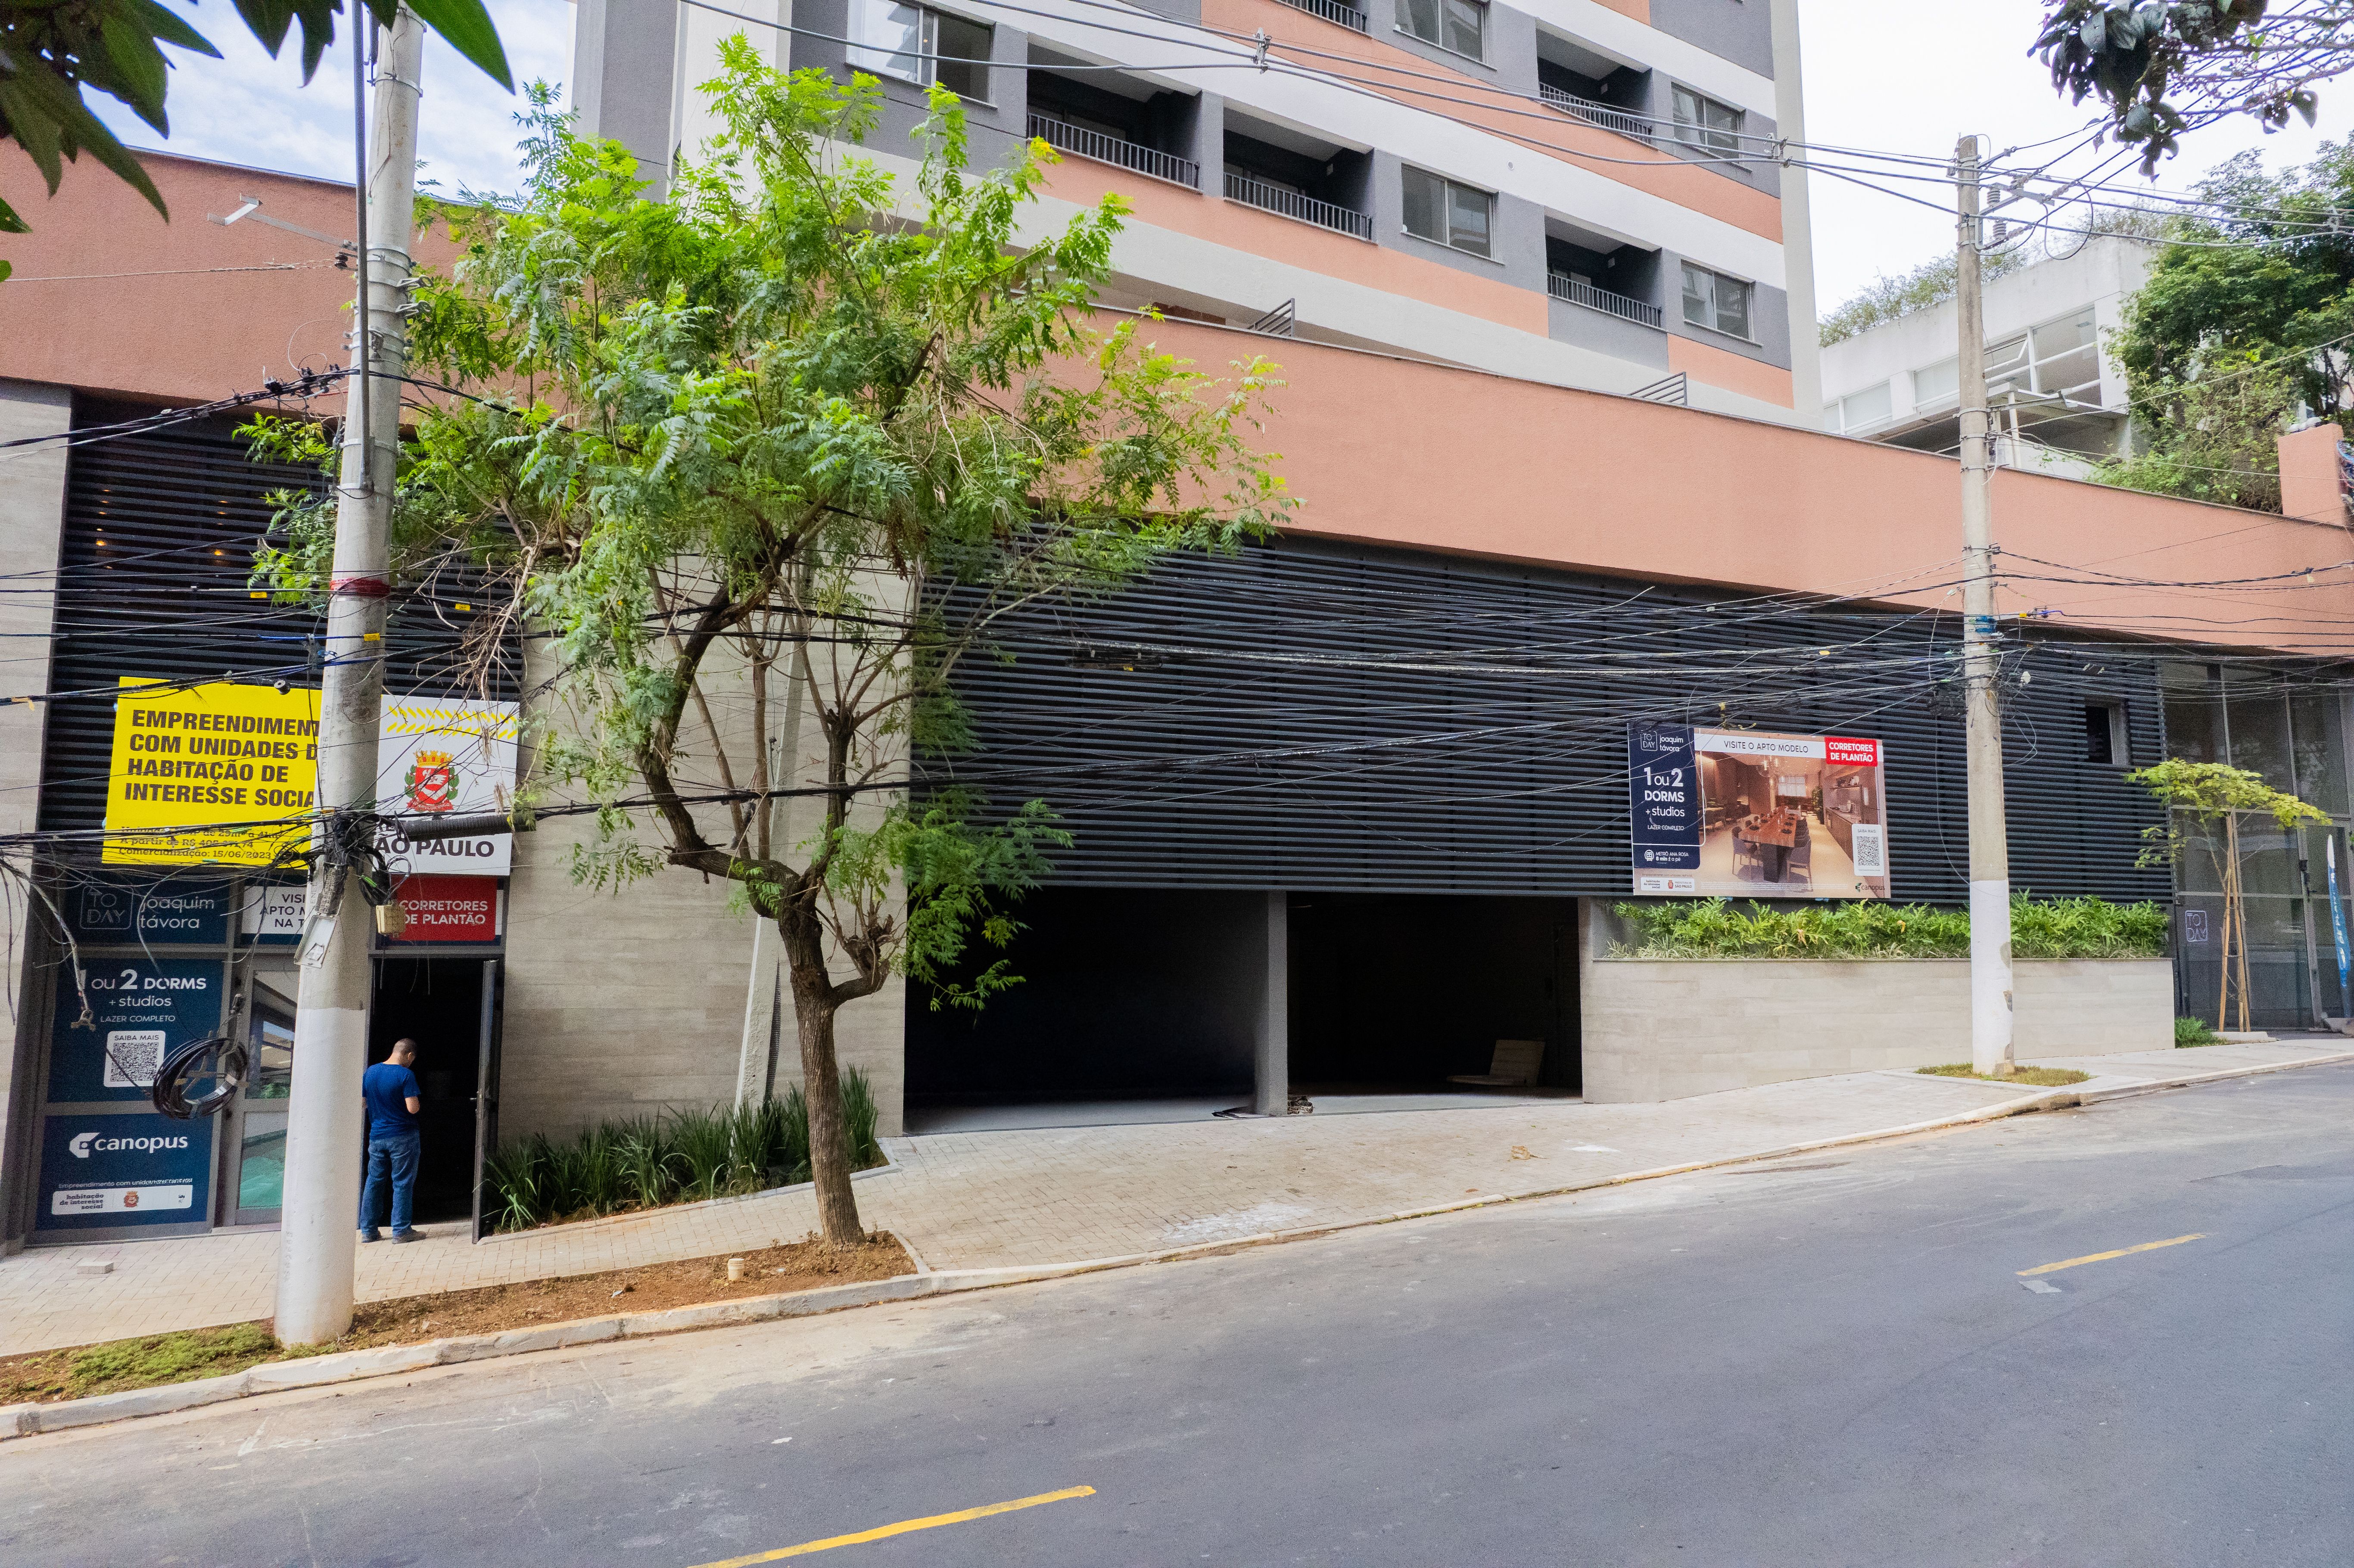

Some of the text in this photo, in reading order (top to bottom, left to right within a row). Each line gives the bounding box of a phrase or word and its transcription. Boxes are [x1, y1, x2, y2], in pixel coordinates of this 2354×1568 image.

[1660, 735, 1684, 744] joaquim
[130, 734, 181, 753] COM
[190, 737, 298, 760] UNIDADES
[1724, 740, 1746, 749] VISITE
[1778, 744, 1809, 753] MODELO
[1828, 742, 1874, 753] CORRETORES
[1841, 753, 1873, 762] PLANTÃO
[128, 758, 288, 784] HABITAÇÃO DE
[1644, 767, 1684, 787] 1 ou 2
[125, 783, 247, 805] INTERESSE
[1644, 790, 1685, 803] DORMS
[416, 839, 494, 857] PAULO
[1861, 884, 1885, 892] canopus
[140, 896, 214, 913] joaquim
[260, 906, 295, 915] APTO
[399, 900, 488, 911] CORRETORES
[140, 915, 199, 928] távora
[275, 918, 293, 927] NA
[423, 912, 486, 924] PLANTÃO
[91, 978, 115, 989] ou
[119, 969, 138, 989] 2
[144, 977, 206, 989] DORMS
[95, 1136, 188, 1154] canopus
